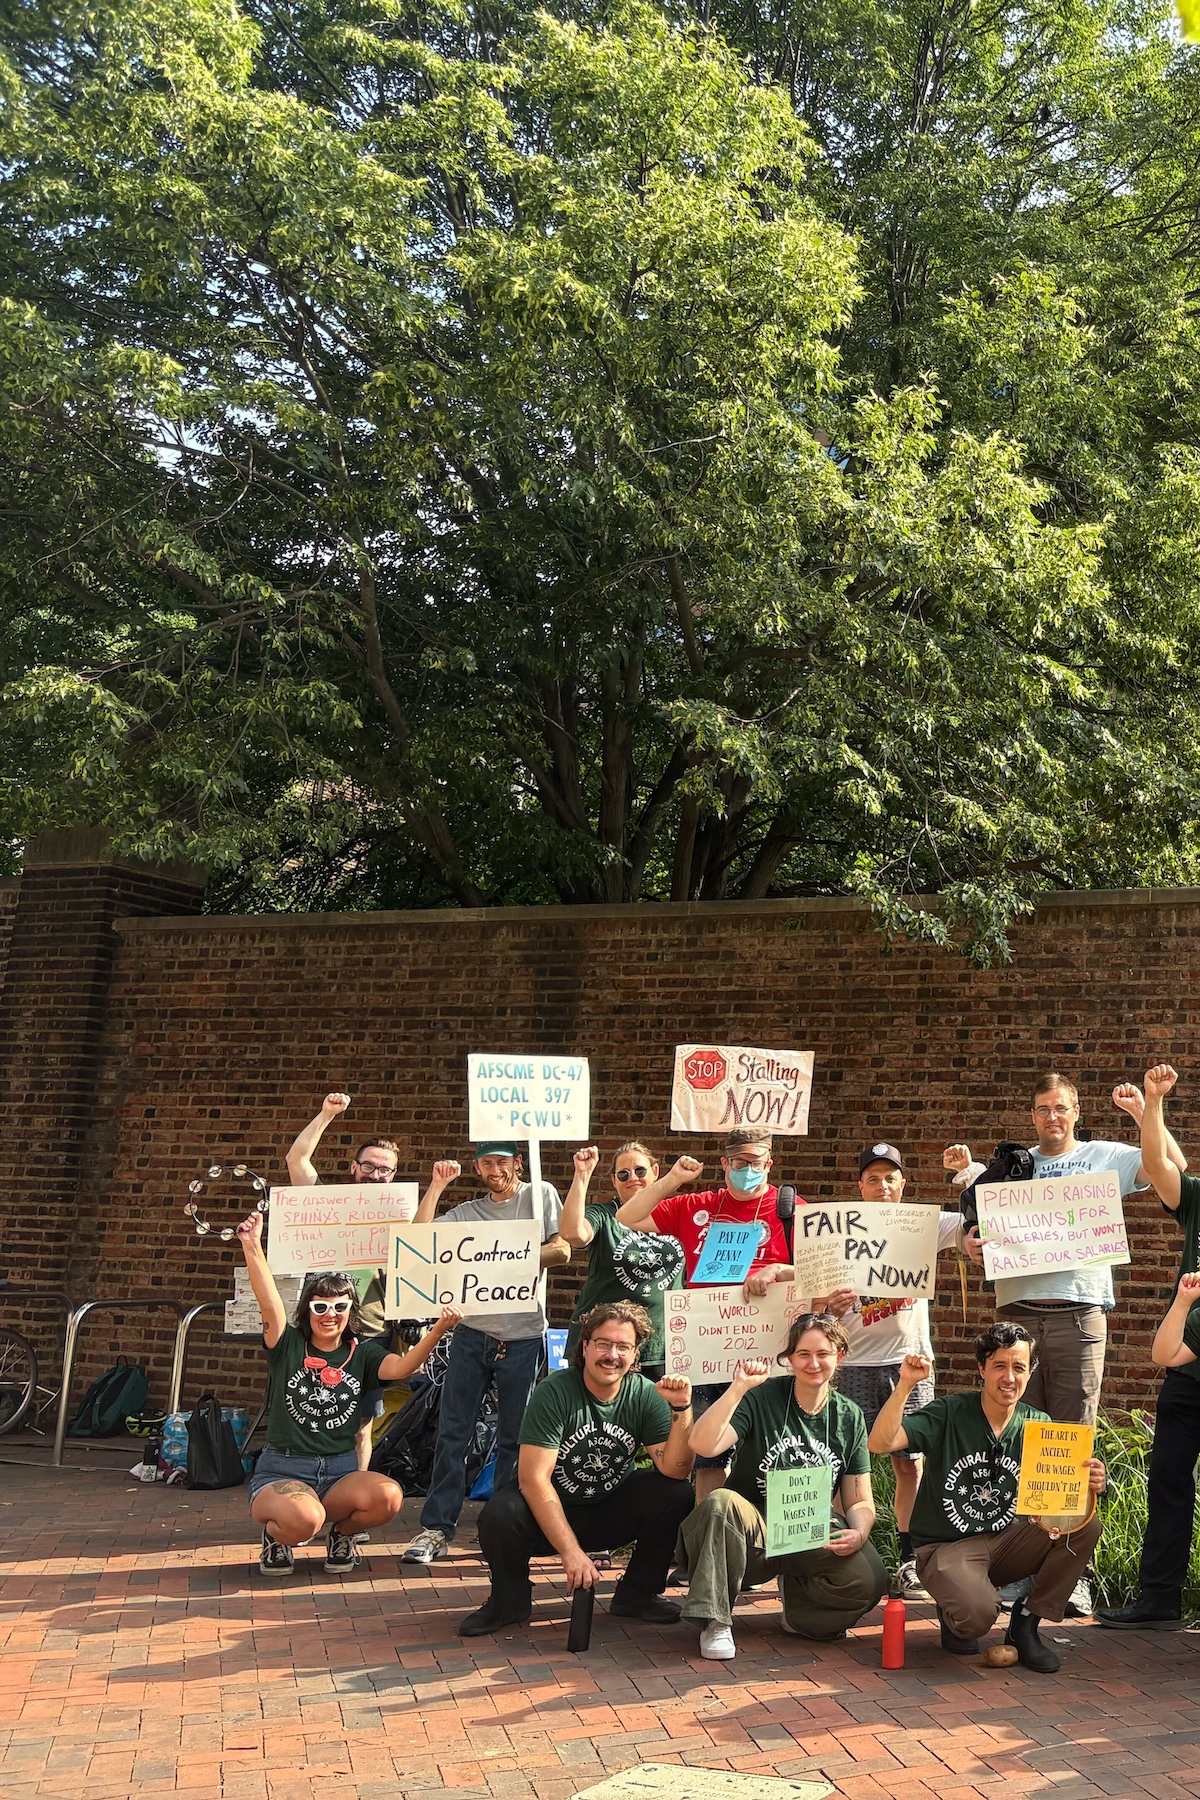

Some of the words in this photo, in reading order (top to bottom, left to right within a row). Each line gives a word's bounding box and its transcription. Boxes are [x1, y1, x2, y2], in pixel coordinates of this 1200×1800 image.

[477, 1062, 535, 1079] AFSCME
[542, 1064, 583, 1081] DC-47
[687, 1059, 723, 1079] STOP
[736, 1053, 800, 1090] Stalling
[480, 1086, 529, 1103] LOCAL
[545, 1086, 571, 1104] 397
[718, 1087, 803, 1128] NOW!
[272, 1189, 298, 1206] The
[303, 1196, 351, 1207] answer
[357, 1191, 370, 1206] to
[377, 1192, 408, 1206] the
[984, 1186, 1034, 1211] PENN
[1042, 1184, 1054, 1200] IS
[1063, 1182, 1117, 1202] RAISING
[349, 1208, 411, 1222] RIDDLE
[1079, 1205, 1110, 1219] FOR
[803, 1210, 868, 1238] FAIR
[1067, 1228, 1089, 1241] BUT
[1092, 1223, 1124, 1238] WON'T
[293, 1227, 324, 1242] that
[337, 1229, 359, 1239] our
[370, 1226, 390, 1243] pa
[718, 1231, 735, 1244] PAY
[736, 1232, 749, 1244] UP
[309, 1245, 337, 1262] too
[395, 1231, 453, 1269] No
[457, 1236, 531, 1263] Contract
[714, 1250, 741, 1262] PENN!
[844, 1238, 887, 1260] PAY
[992, 1254, 1039, 1273] RAISE
[1044, 1250, 1072, 1263] OUR
[1077, 1240, 1127, 1260] SALARIES
[657, 1263, 683, 1291] UNITED
[867, 1264, 930, 1290] NOW!
[395, 1274, 454, 1307] No
[461, 1274, 538, 1304] Peace!
[706, 1292, 731, 1302] THE
[718, 1305, 760, 1320] WORLD
[733, 1325, 757, 1334] END
[761, 1324, 774, 1332] IN
[723, 1337, 759, 1350] 2012
[702, 1361, 723, 1374] BUT
[285, 1394, 307, 1425] PHILLY
[326, 1401, 357, 1430] UNITED
[299, 1401, 321, 1416] LOCAL
[324, 1405, 339, 1416] 397
[1040, 1428, 1055, 1440] THE
[1056, 1430, 1068, 1441] ART
[1070, 1432, 1078, 1441] IS
[759, 1435, 804, 1472] CULTURAL
[1040, 1447, 1071, 1459] ANCIENT.
[574, 1469, 598, 1482] LOCAL
[944, 1451, 989, 1491] CULTURAL
[1036, 1462, 1051, 1474] OUR
[1053, 1463, 1075, 1475] WAGES
[789, 1475, 811, 1487] DON'T
[1027, 1480, 1068, 1493] SHOULDN'T
[1069, 1481, 1081, 1493] BE!
[782, 1493, 802, 1505] LEAVE
[803, 1490, 818, 1501] OUR
[783, 1508, 806, 1520] WAGES
[807, 1506, 816, 1516] IN
[942, 1498, 970, 1533] PHILLY
[962, 1502, 985, 1521] LOCAL
[788, 1522, 810, 1536] RUINS!
